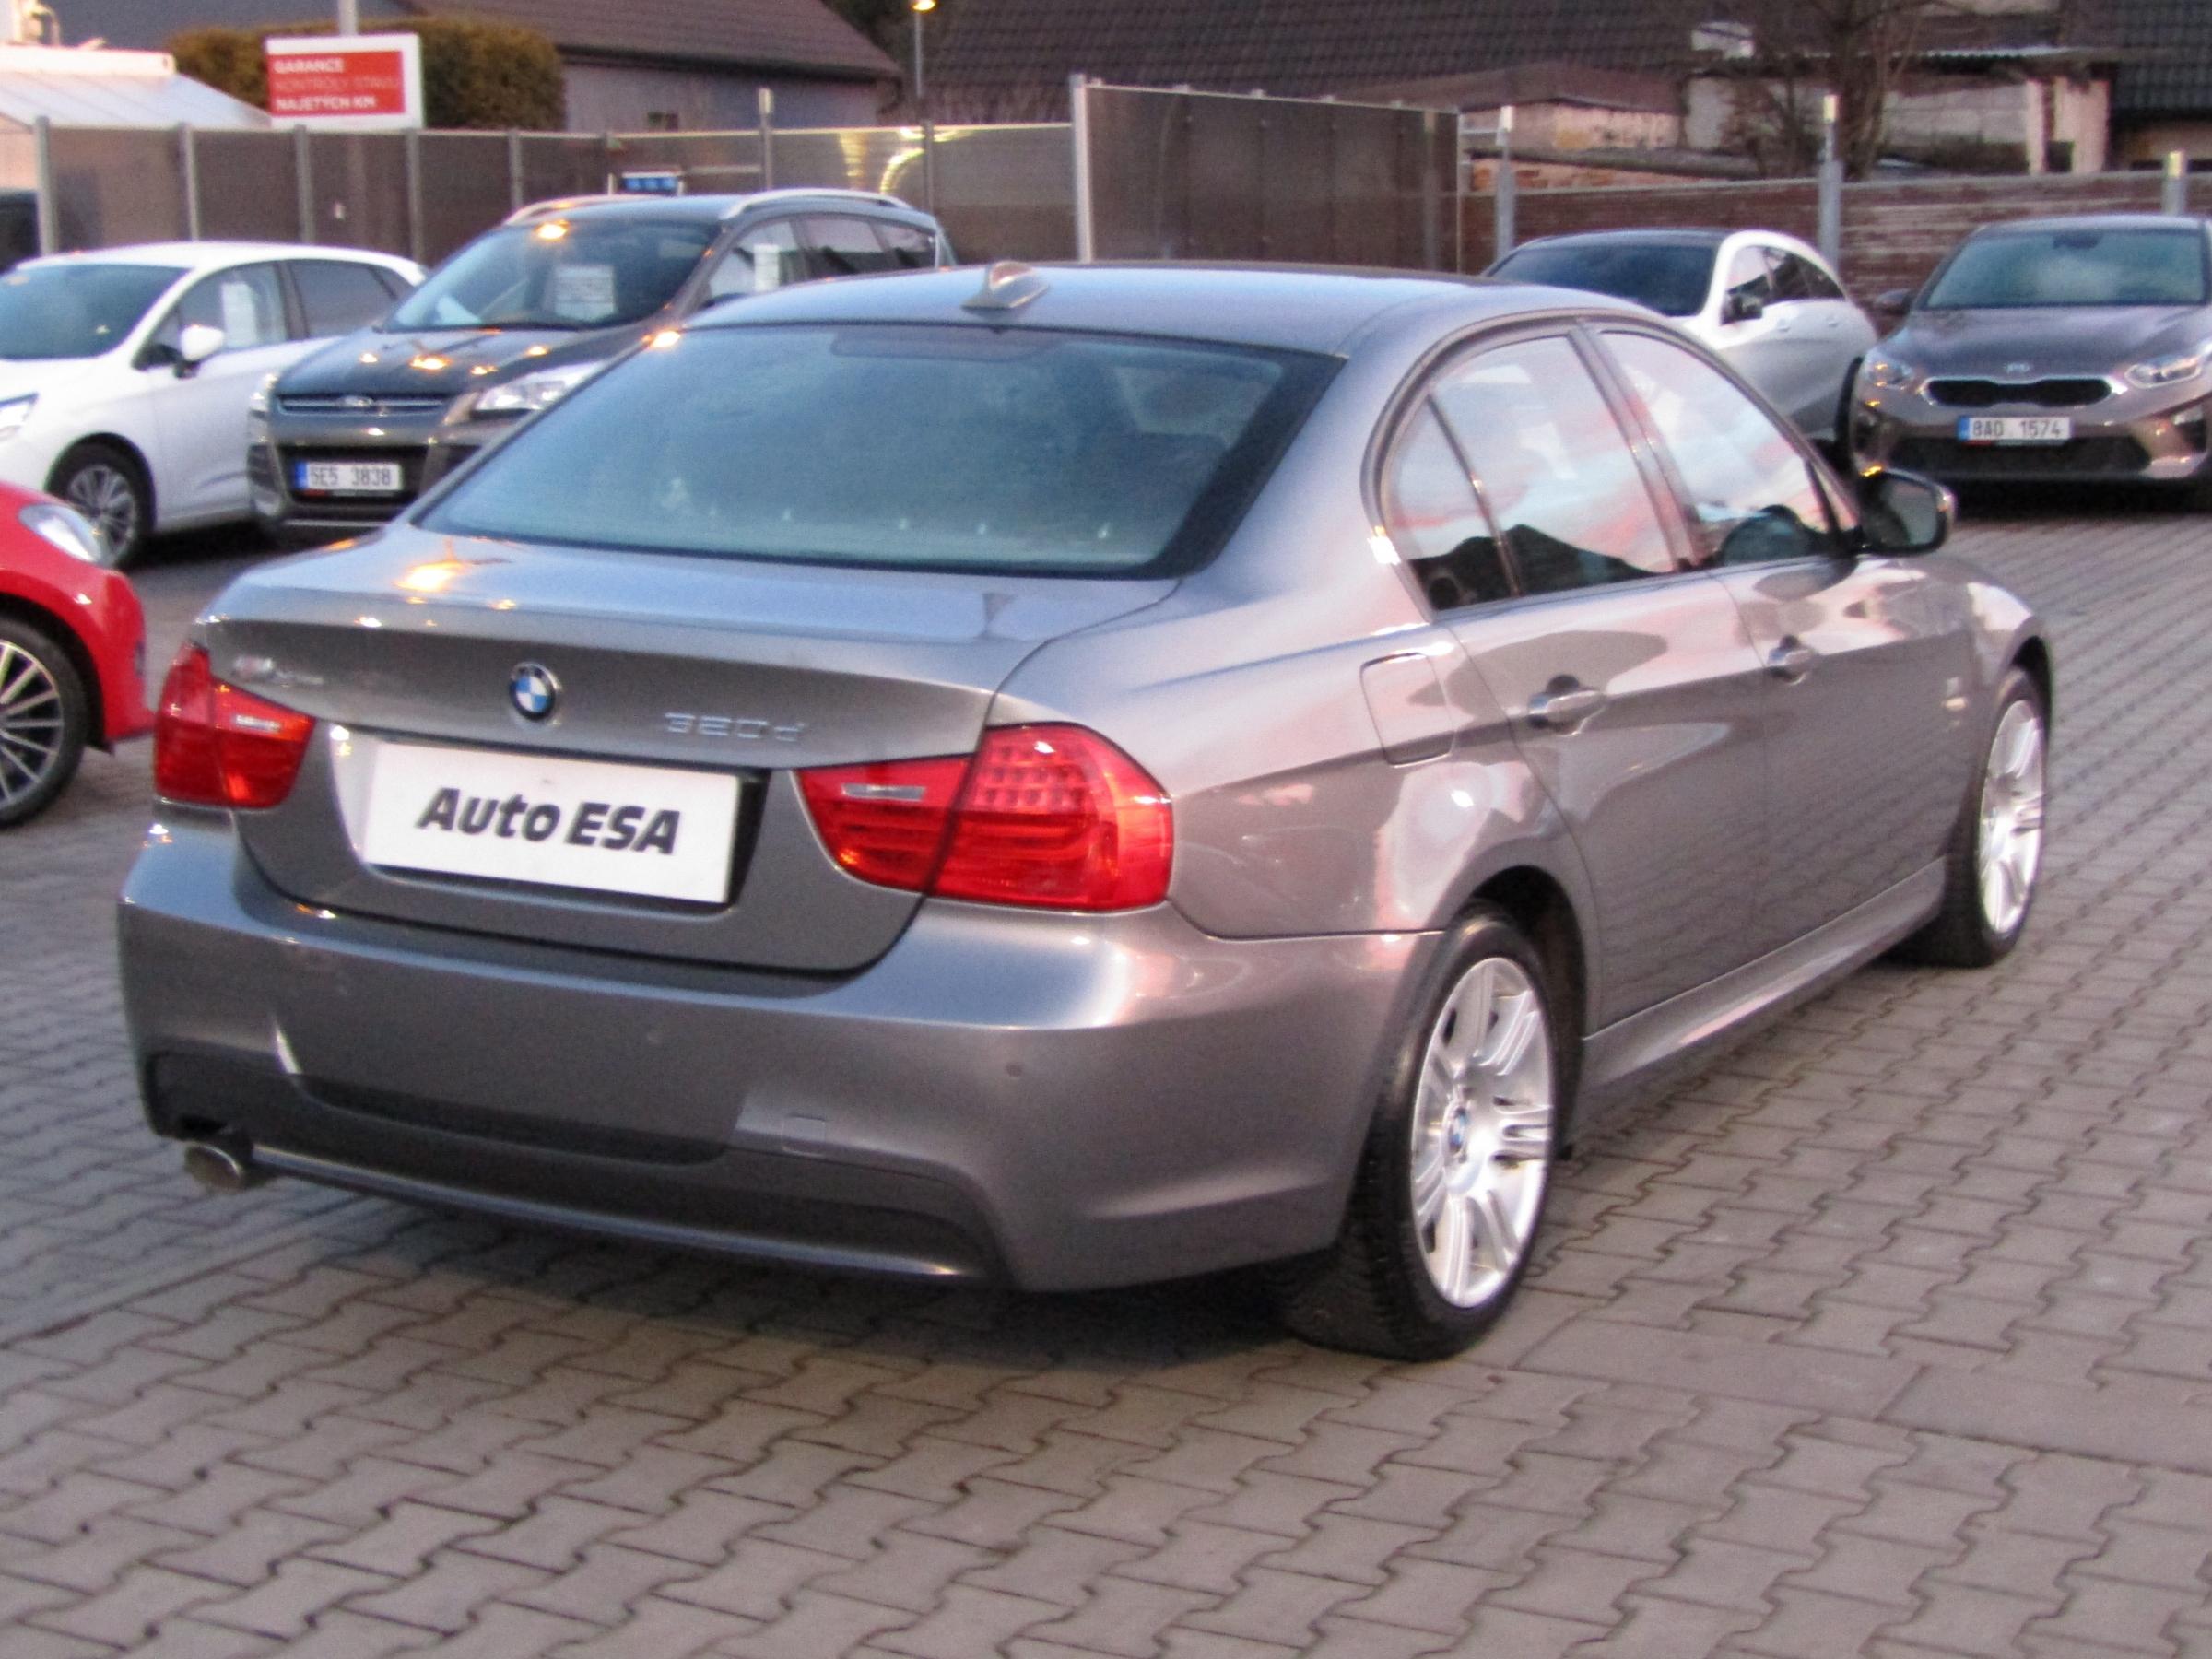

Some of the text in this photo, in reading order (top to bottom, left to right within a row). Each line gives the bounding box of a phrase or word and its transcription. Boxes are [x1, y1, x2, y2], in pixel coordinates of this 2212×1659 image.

[273, 57, 344, 74] GARANCE
[2019, 419, 2061, 438] 1574
[351, 466, 391, 486] 3838
[415, 787, 681, 855] Auto ESA
